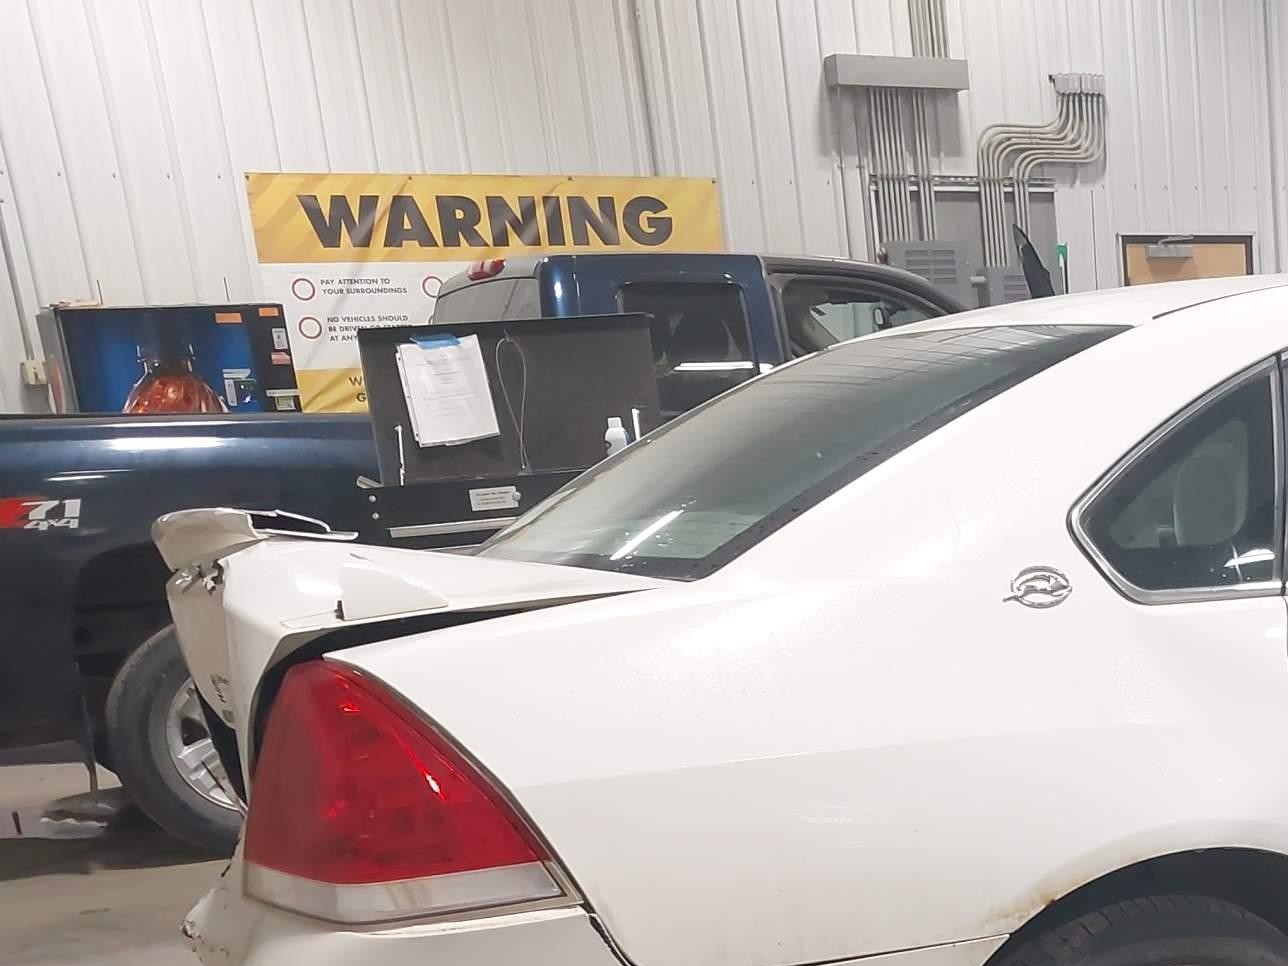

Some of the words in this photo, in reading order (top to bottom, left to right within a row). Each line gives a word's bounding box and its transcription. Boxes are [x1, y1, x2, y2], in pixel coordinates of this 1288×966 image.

[297, 194, 673, 248] WARNING
[378, 314, 408, 322] SHOULD
[23, 518, 79, 530] 4x4
